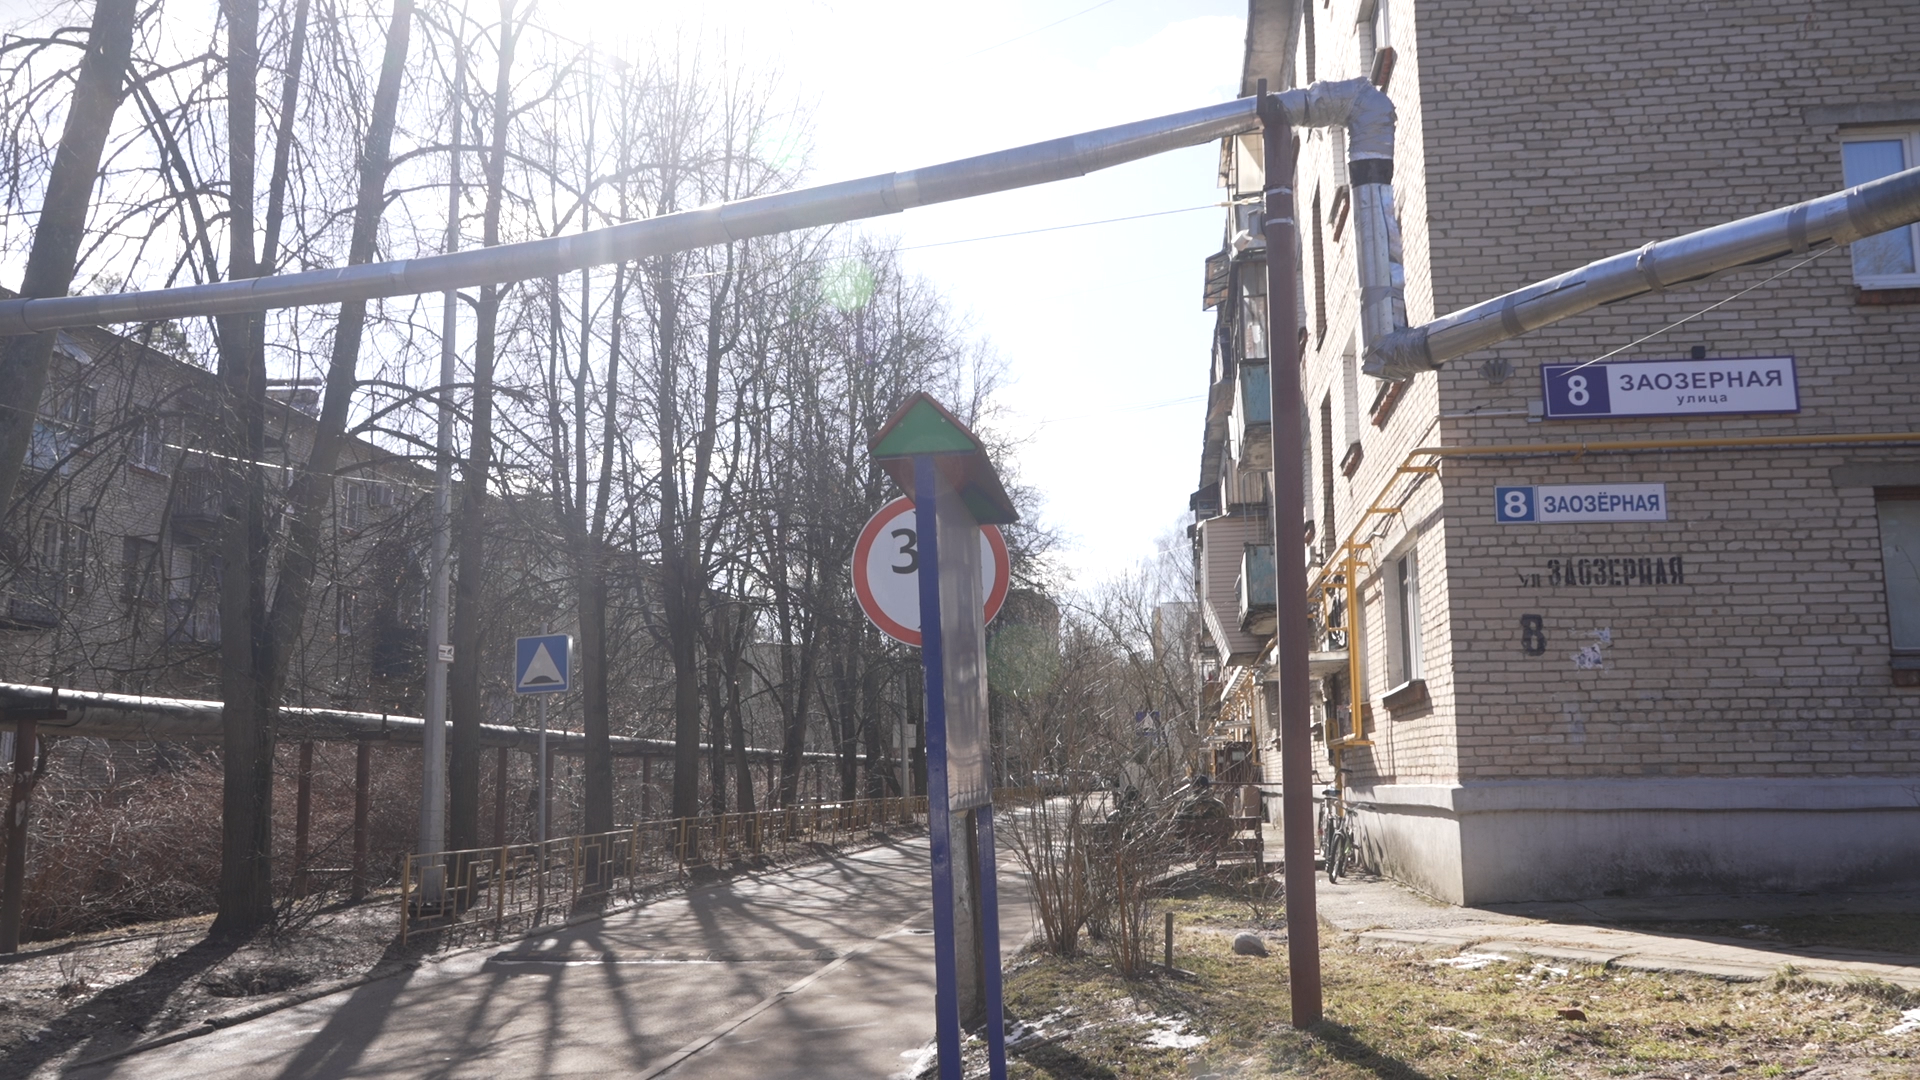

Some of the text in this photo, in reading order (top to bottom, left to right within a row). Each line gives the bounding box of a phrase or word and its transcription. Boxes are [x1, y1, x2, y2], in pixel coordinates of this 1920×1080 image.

[1567, 370, 1783, 406] 8 ЗАОЗЕРНАЯ
[1676, 394, 1728, 406] улица
[1503, 491, 1660, 518] 8 ЗАОЗЁРНАЯ
[1547, 556, 1684, 586] ЗАОЗЕРНАЯ
